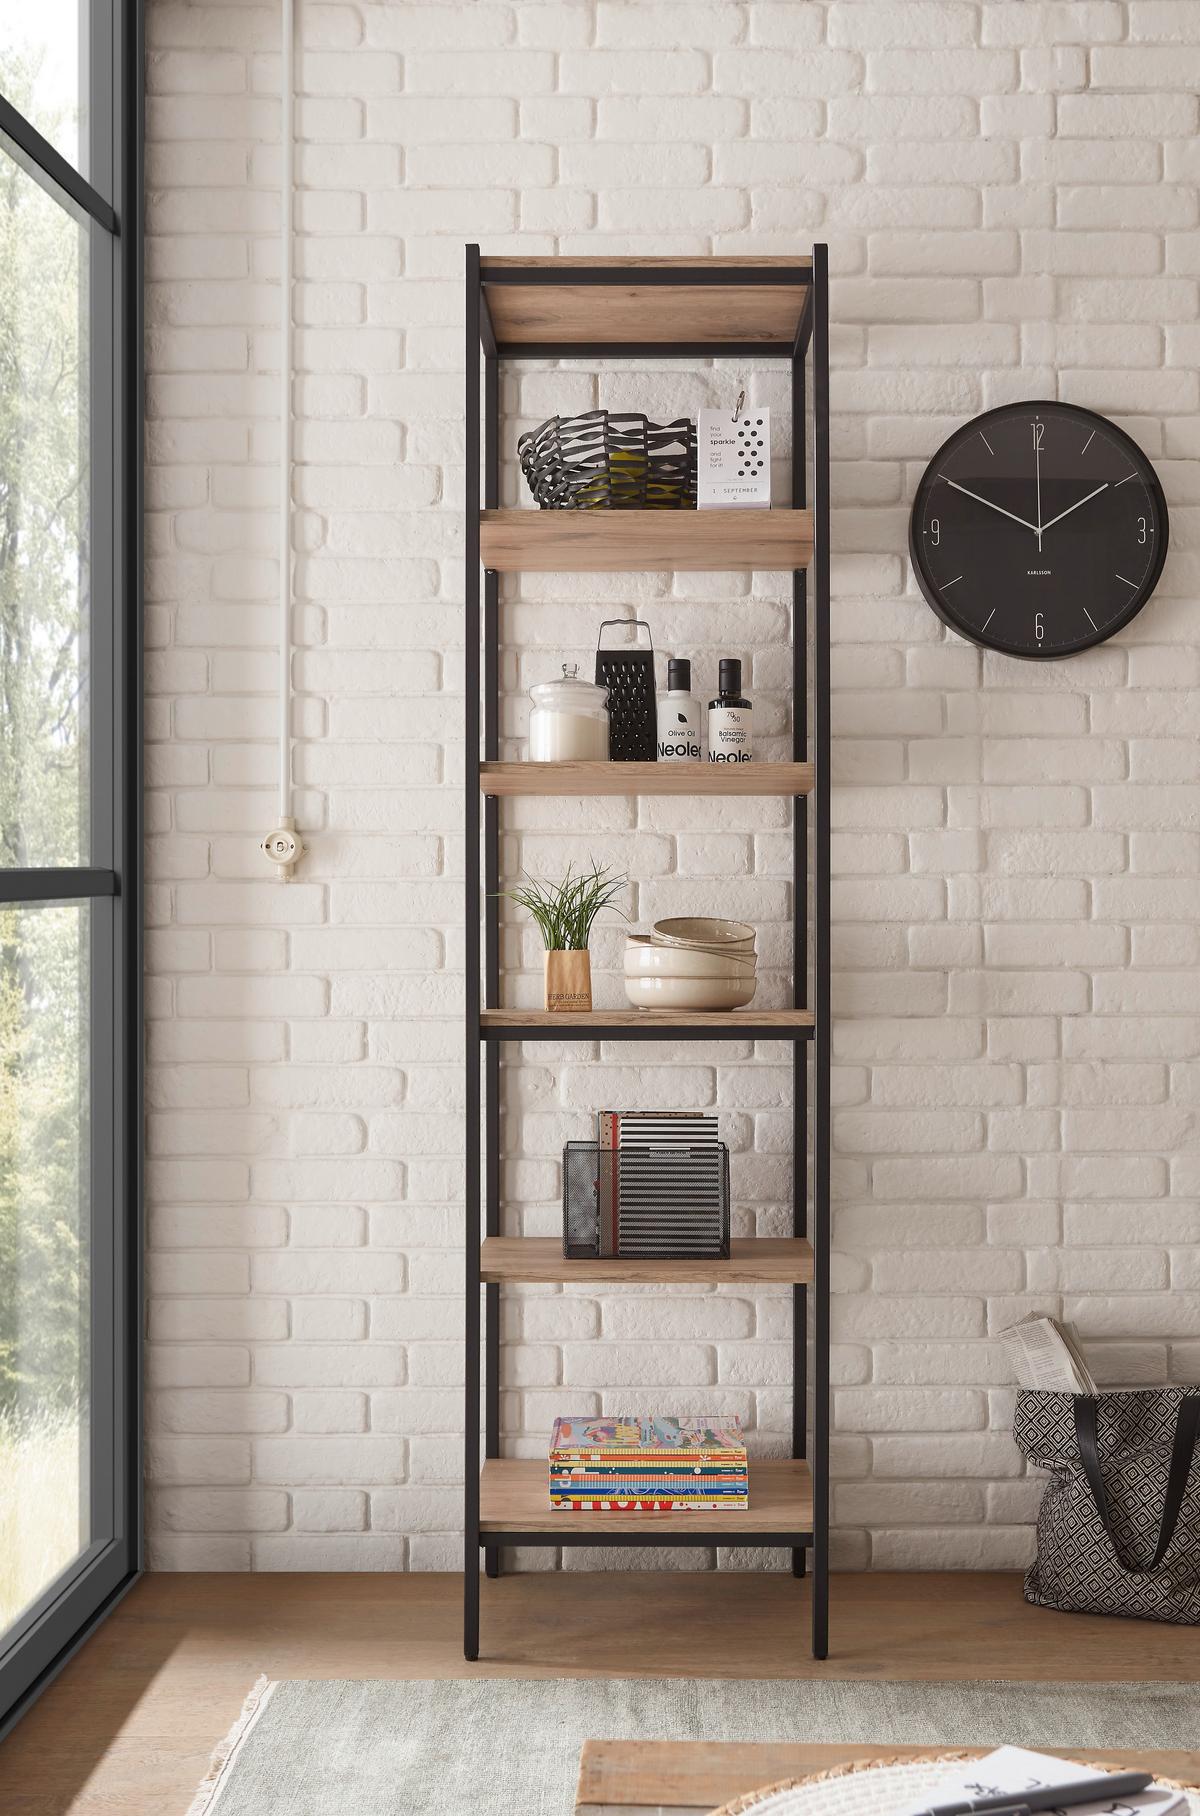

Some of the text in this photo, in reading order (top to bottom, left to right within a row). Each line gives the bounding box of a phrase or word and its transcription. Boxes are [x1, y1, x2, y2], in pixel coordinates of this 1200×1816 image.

[1030, 423, 1045, 450] 12
[931, 519, 940, 545] 9
[1137, 517, 1146, 543] 3
[1035, 613, 1044, 640] 6
[708, 750, 752, 763] Neole
